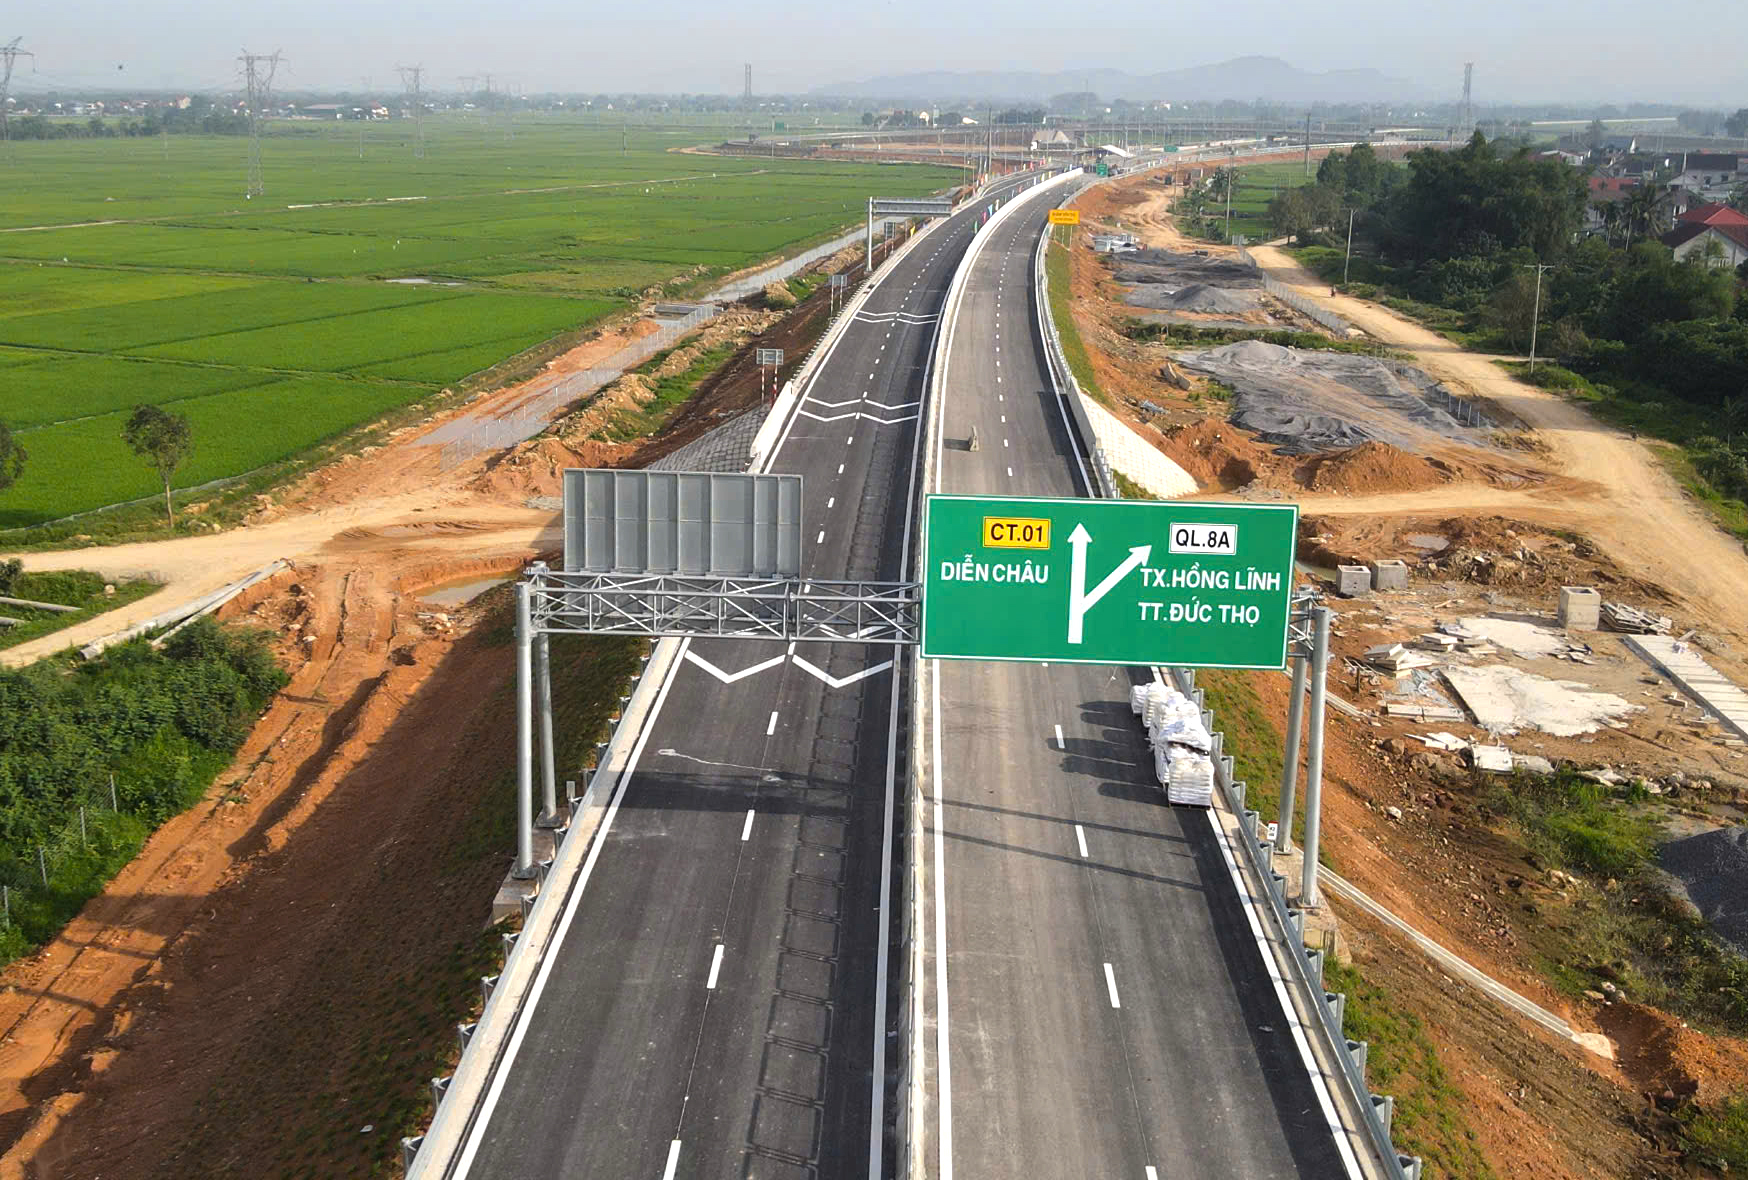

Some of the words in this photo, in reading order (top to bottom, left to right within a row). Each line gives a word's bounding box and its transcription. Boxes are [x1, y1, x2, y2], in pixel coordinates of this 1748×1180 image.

[990, 523, 1043, 542] CT.01
[1175, 529, 1230, 549] QL.8A
[941, 554, 989, 582] DIỄN
[992, 559, 1049, 584] CHÂU
[1140, 561, 1229, 590] TX.HỒNG
[1235, 566, 1280, 591] LĨNH
[1138, 596, 1212, 623] TT.ĐỨC
[1218, 604, 1260, 627] THỌ
